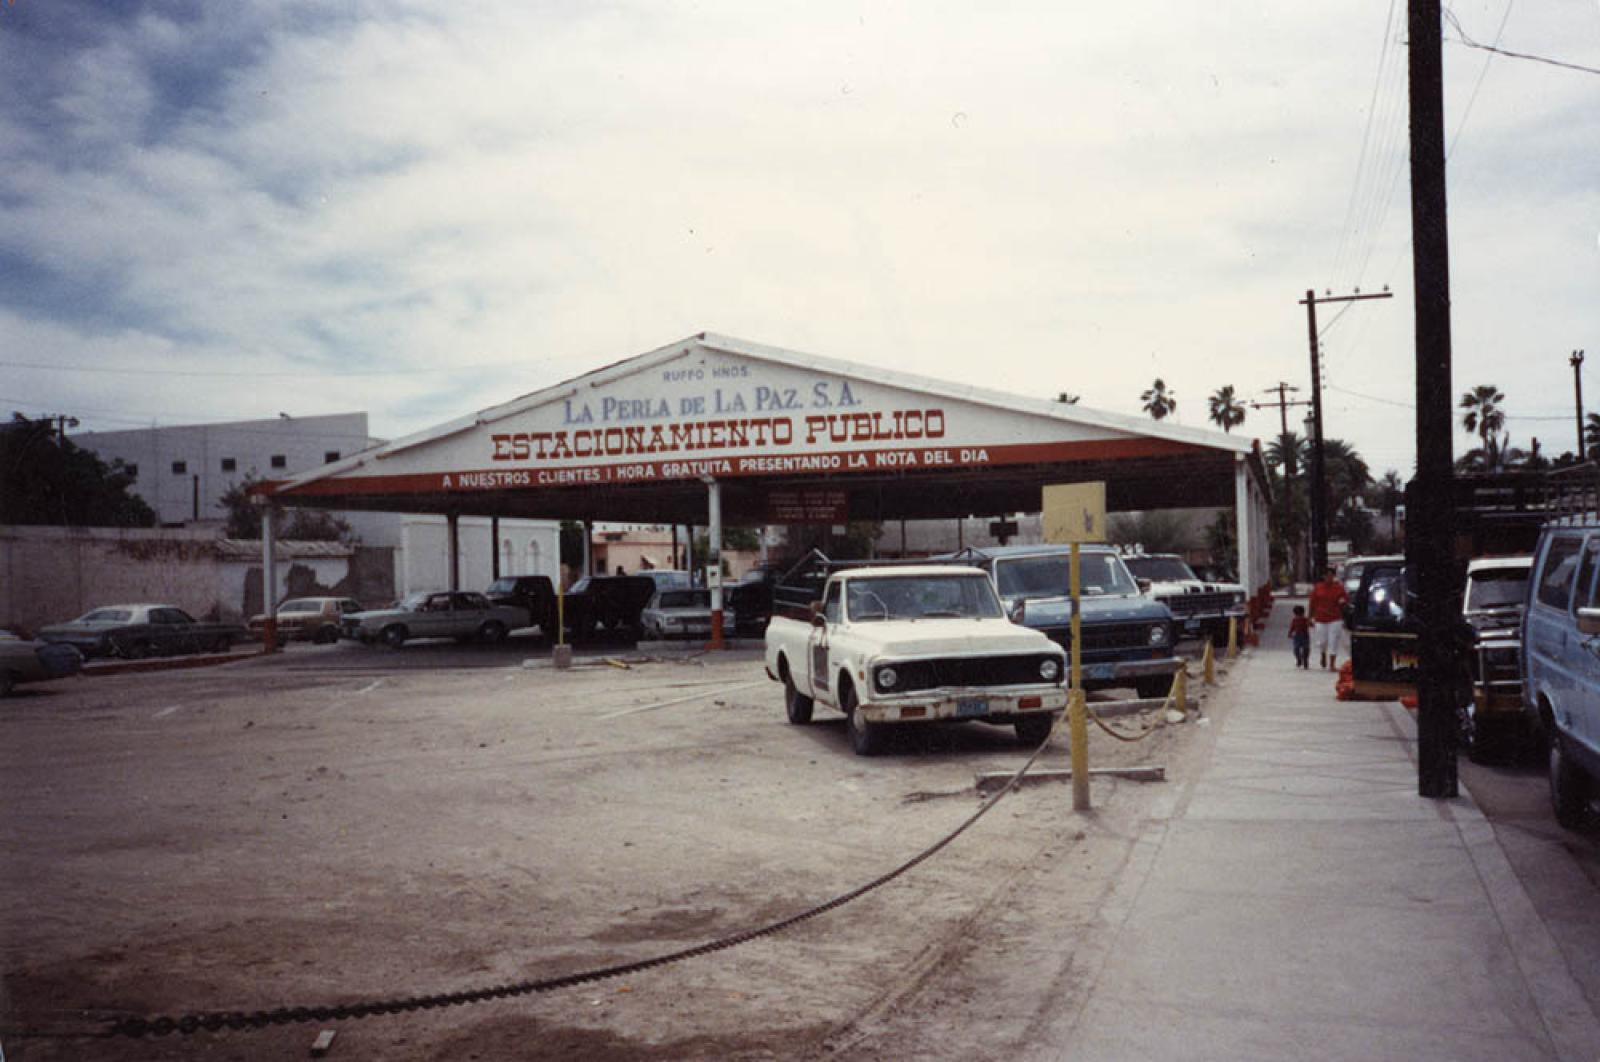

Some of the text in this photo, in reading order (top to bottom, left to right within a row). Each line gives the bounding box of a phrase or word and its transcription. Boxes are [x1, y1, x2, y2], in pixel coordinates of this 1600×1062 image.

[663, 369, 704, 381] RUFFO
[563, 400, 593, 424] LA
[602, 396, 670, 421] PERLA
[680, 396, 705, 417] DE
[714, 389, 747, 413] LA
[491, 409, 945, 461] ESTACIONAMIENTO PUBLICO
[442, 475, 452, 488] A
[459, 471, 529, 489] NUESTROS
[537, 468, 600, 484] CLIENTES
[617, 465, 655, 480] HORA
[662, 459, 732, 477] GRATUITA
[739, 455, 841, 472] PRESENTANDO
[848, 453, 868, 467] LA
[876, 450, 916, 465] NOTA
[924, 449, 953, 464] DEL
[961, 448, 989, 463] DIA
